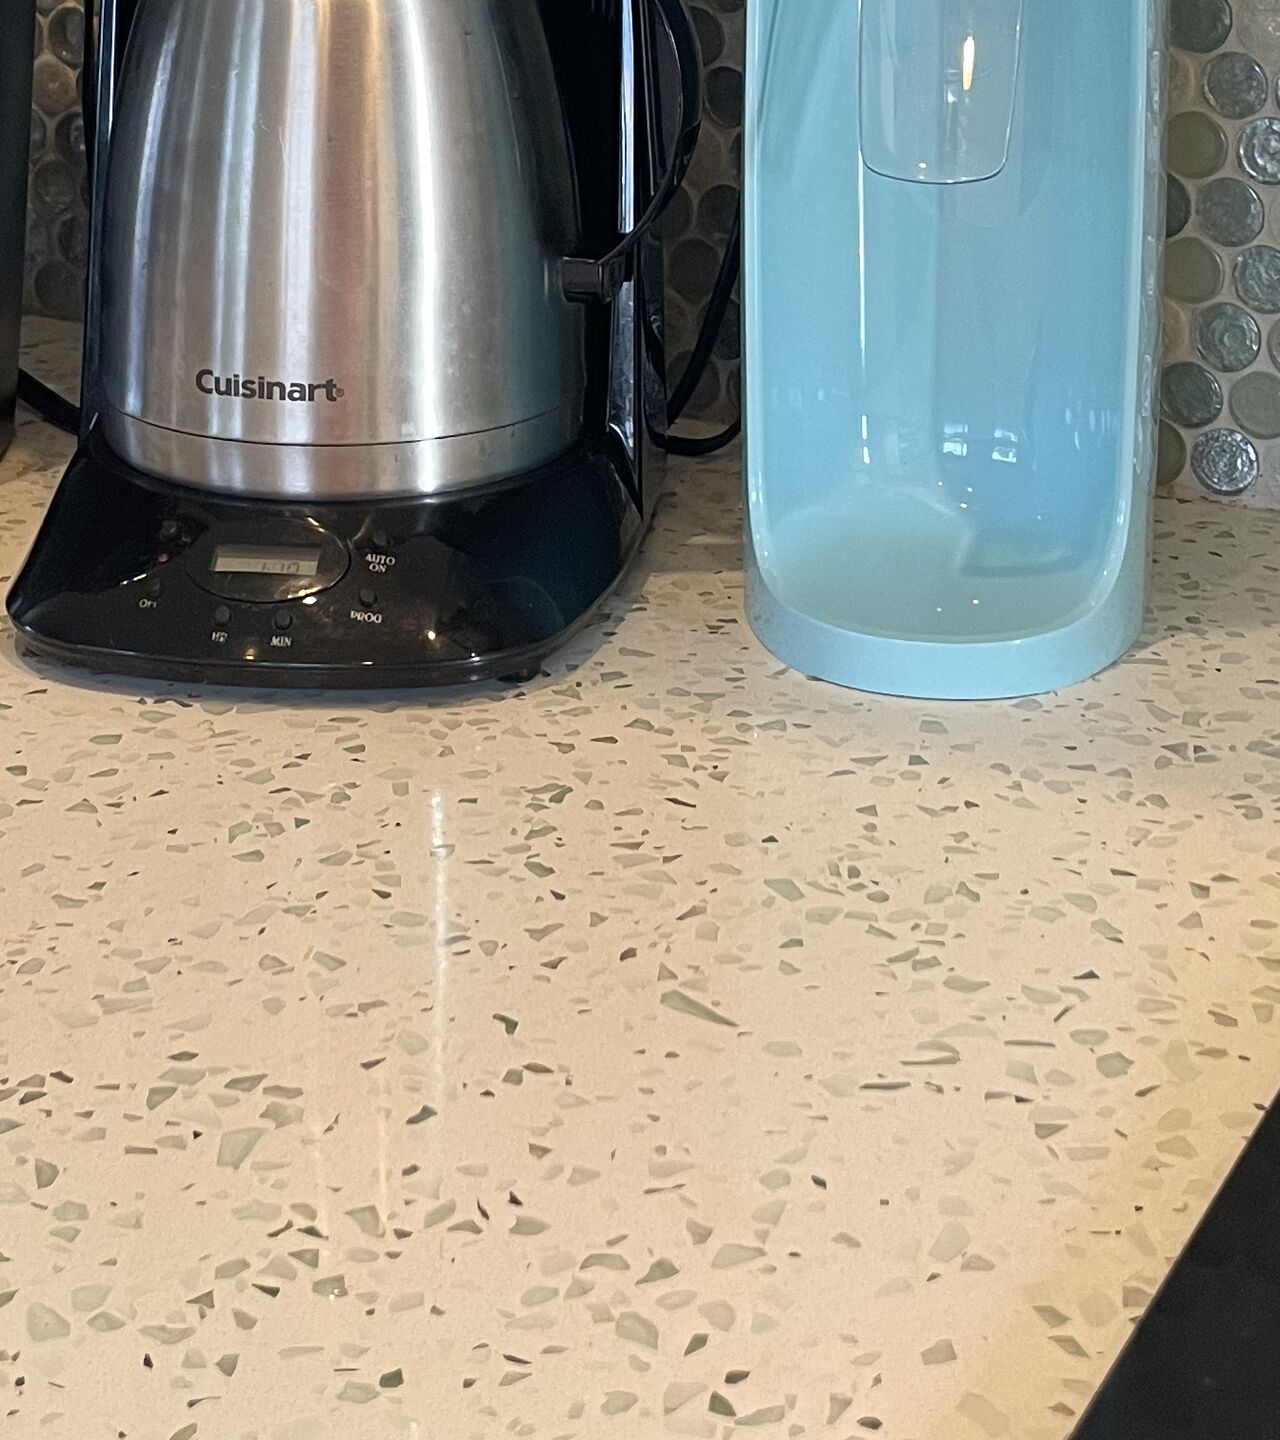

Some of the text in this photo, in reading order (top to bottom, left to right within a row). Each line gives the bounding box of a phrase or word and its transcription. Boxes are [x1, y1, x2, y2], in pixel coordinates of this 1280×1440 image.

[195, 368, 338, 402] Cuisinart
[365, 553, 396, 566] AUTO
[368, 562, 387, 573] ON
[269, 635, 292, 647] MIN
